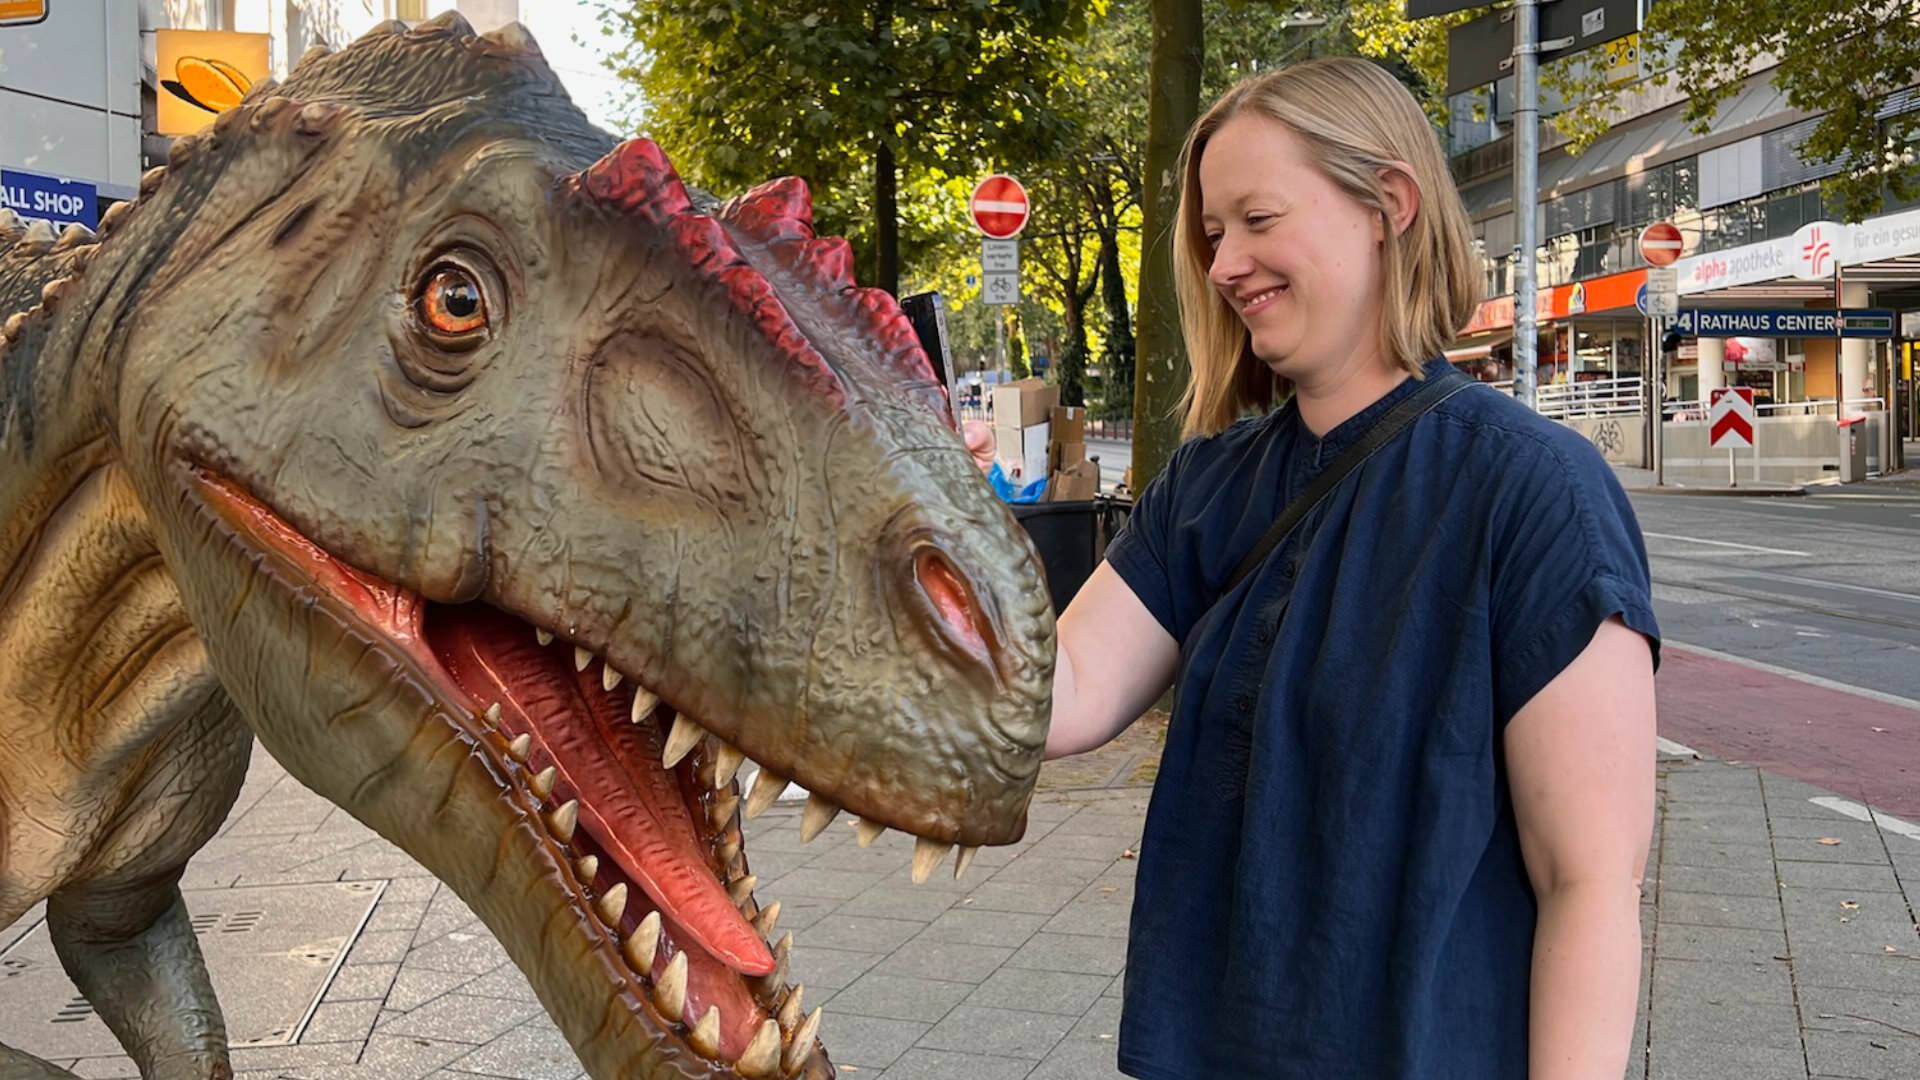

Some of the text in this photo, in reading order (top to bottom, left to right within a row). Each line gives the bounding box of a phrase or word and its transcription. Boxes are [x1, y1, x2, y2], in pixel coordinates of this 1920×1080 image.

[34, 190, 84, 216] SHOP
[1872, 227, 1889, 247] ein
[1892, 223, 1920, 248] gesu
[1694, 258, 1727, 285] alpha
[1728, 244, 1784, 280] apotheke
[1664, 313, 1835, 331] P4 RATHAUS CENTER
